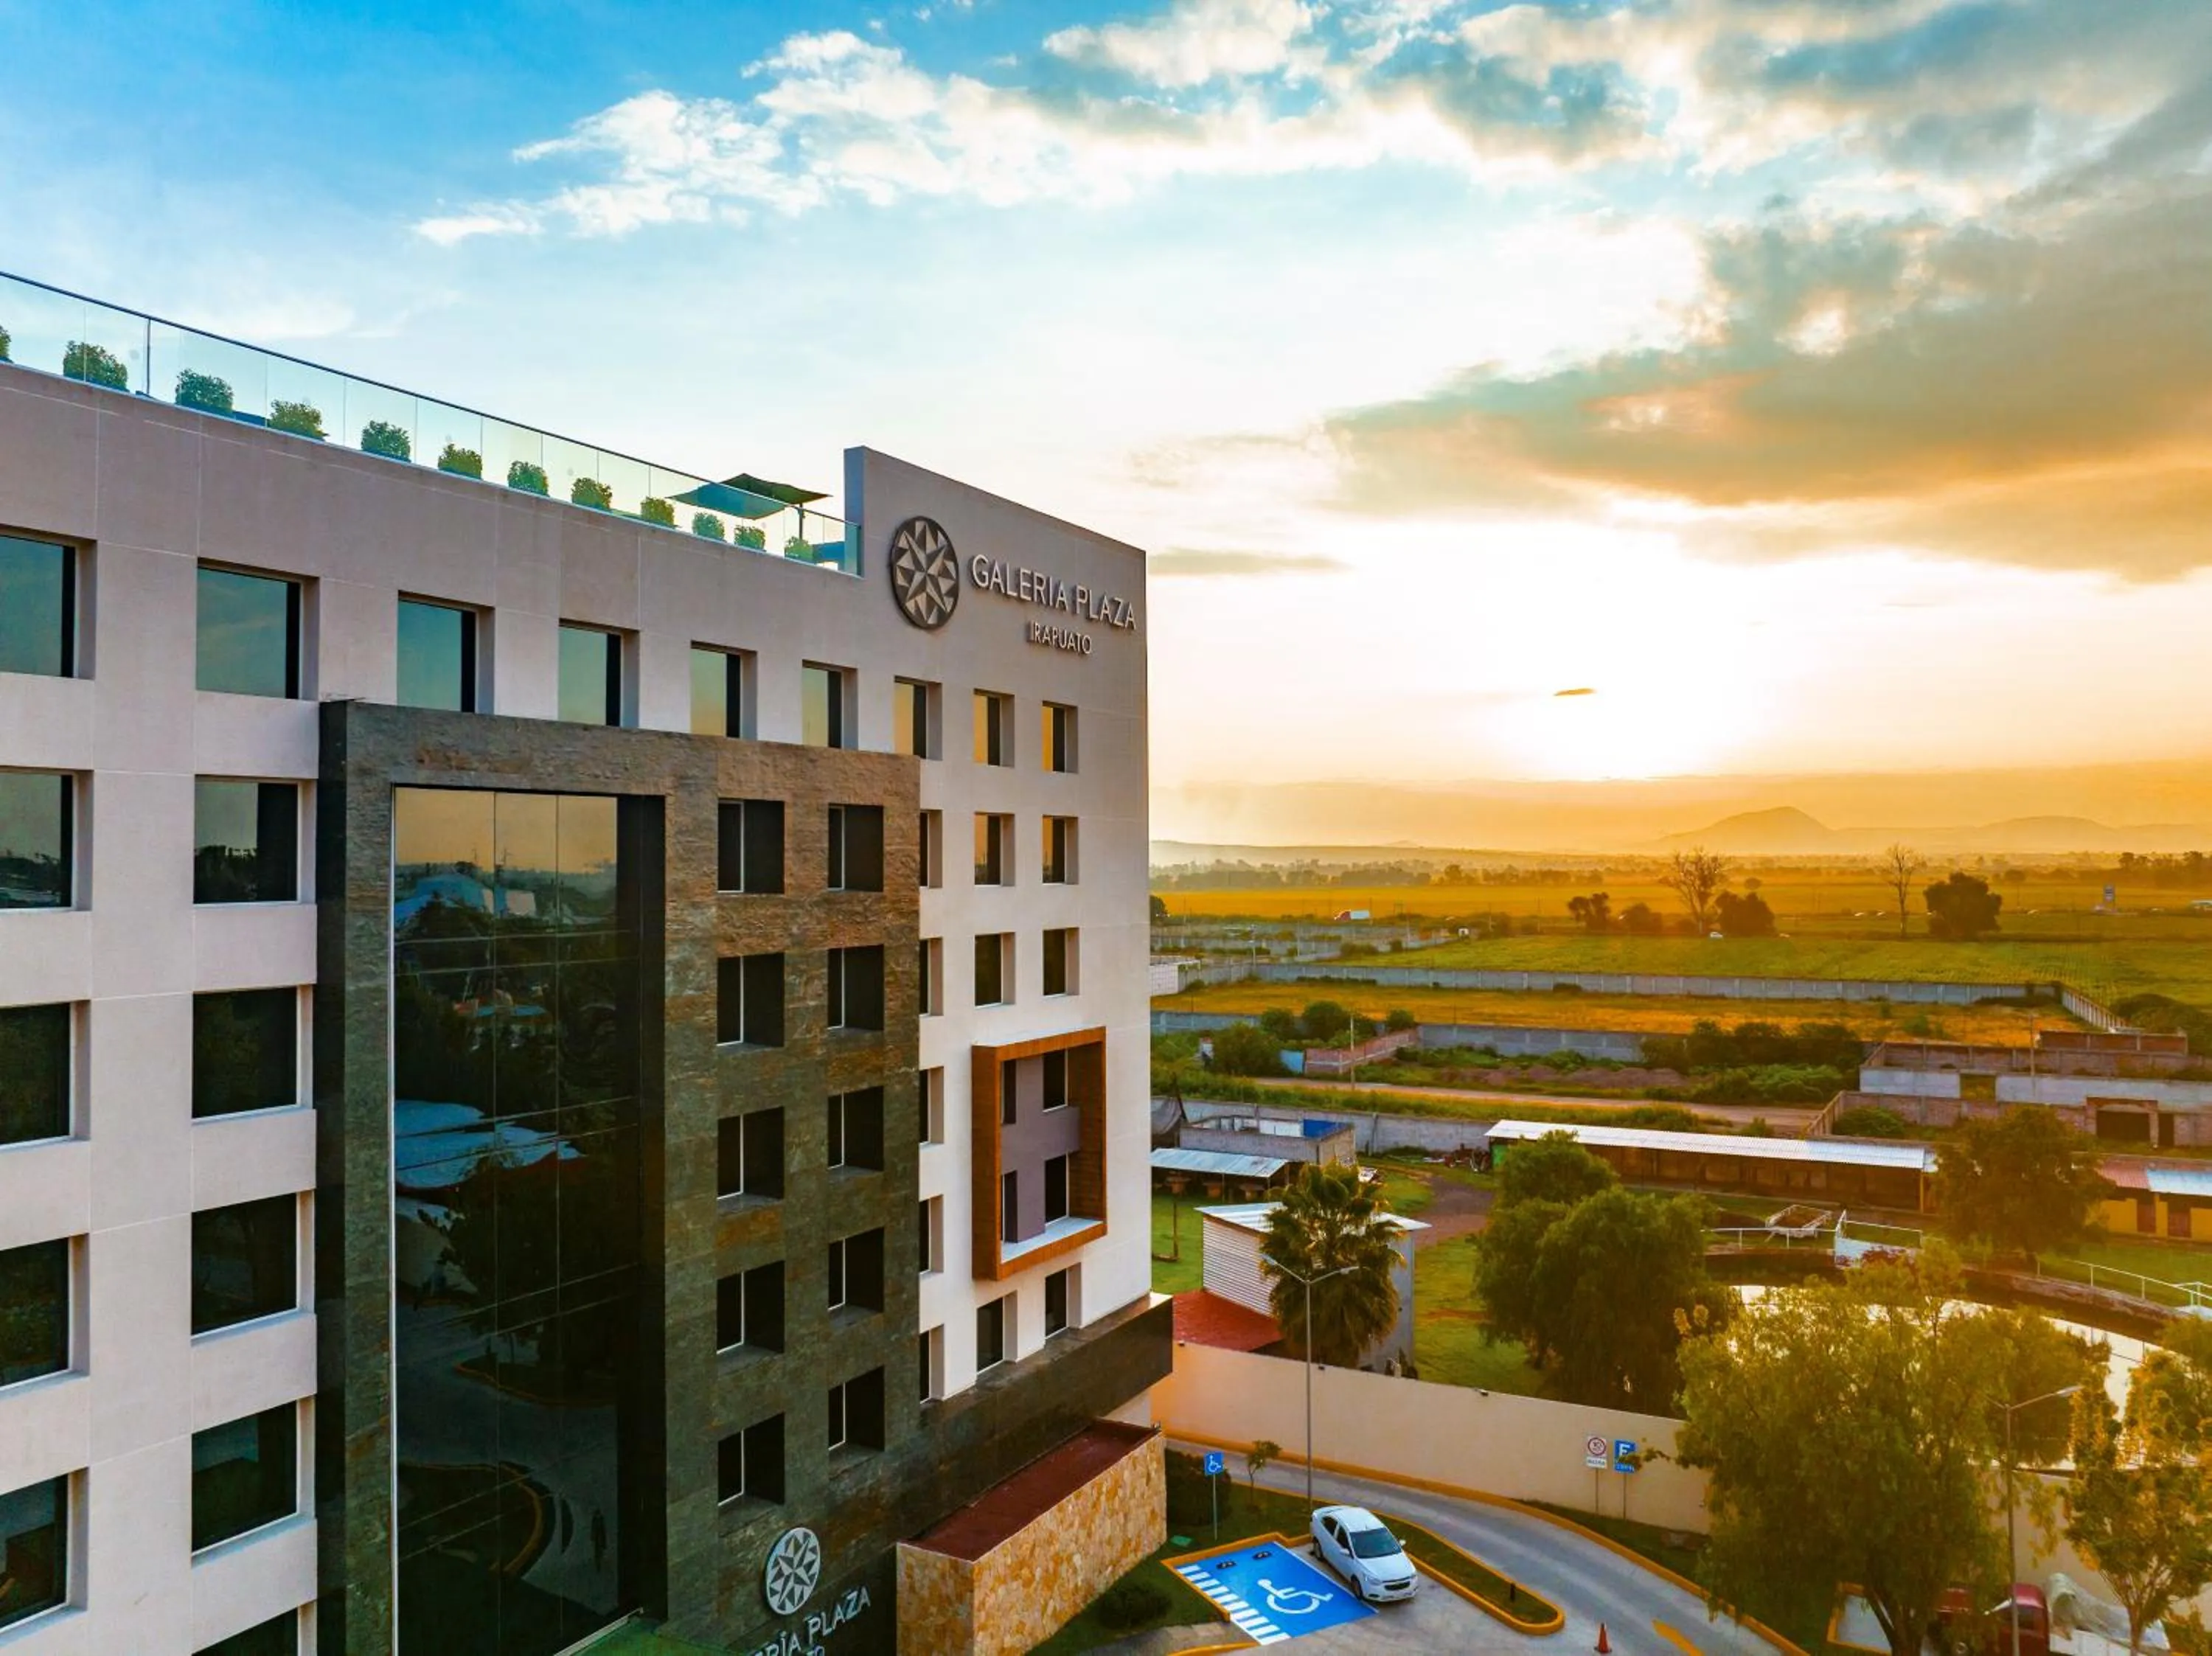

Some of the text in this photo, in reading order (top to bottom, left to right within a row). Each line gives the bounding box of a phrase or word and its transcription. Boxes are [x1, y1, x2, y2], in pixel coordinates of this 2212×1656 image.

[970, 554, 1137, 629] GALERIA PLAZA
[1029, 620, 1092, 654] IRAPUATO
[807, 1586, 871, 1645] PLAZA
